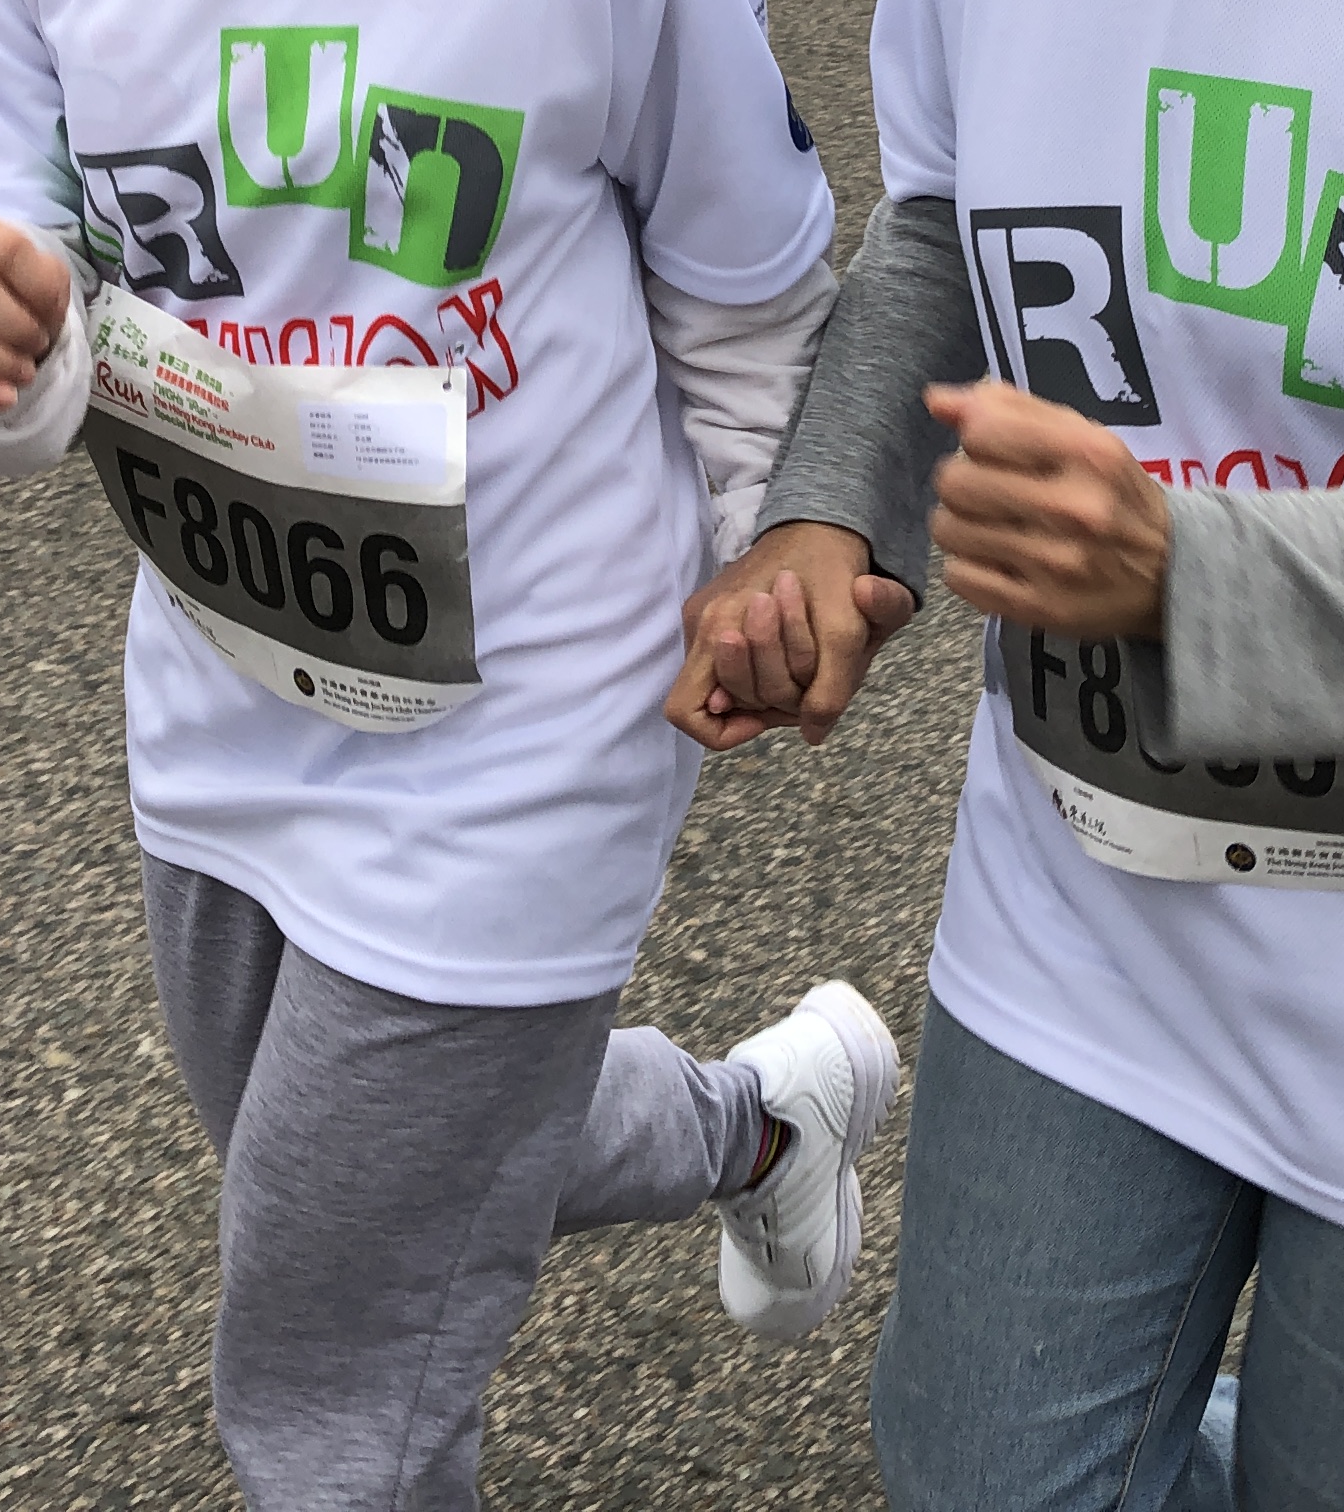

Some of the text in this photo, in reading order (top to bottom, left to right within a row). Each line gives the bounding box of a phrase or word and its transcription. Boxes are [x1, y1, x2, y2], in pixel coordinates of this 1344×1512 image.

[169, 403, 191, 423] Hong
[191, 414, 215, 435] Kong
[217, 424, 249, 446] Jockey
[251, 435, 276, 451] Club
[115, 445, 430, 648] F8066
